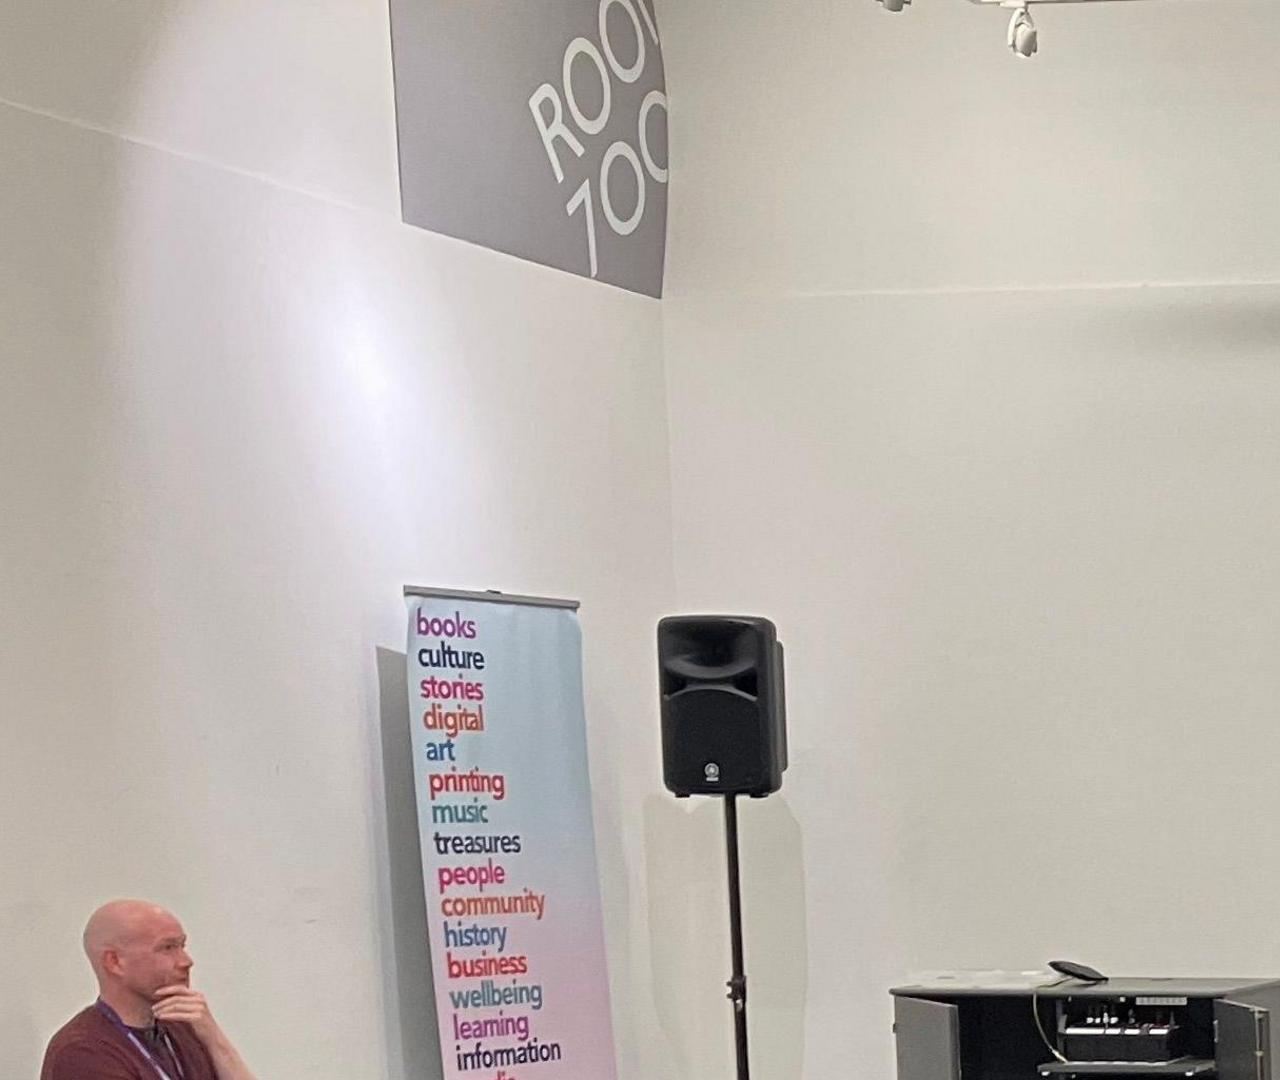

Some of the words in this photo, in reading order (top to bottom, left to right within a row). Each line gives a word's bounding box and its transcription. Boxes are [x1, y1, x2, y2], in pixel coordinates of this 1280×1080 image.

[528, 0, 659, 183] ROO
[417, 607, 476, 639] books
[418, 641, 485, 670] culture
[420, 673, 485, 701] stories
[423, 703, 485, 738] digital
[426, 740, 456, 761] art
[429, 767, 505, 800] printing
[432, 798, 488, 824] music
[434, 832, 521, 855] treasures
[438, 859, 505, 894] people
[441, 888, 545, 921] community
[444, 921, 507, 952] history
[447, 951, 527, 979] business
[450, 979, 543, 1010] wellbeing
[454, 1011, 530, 1041] learning
[457, 1037, 561, 1071] information
